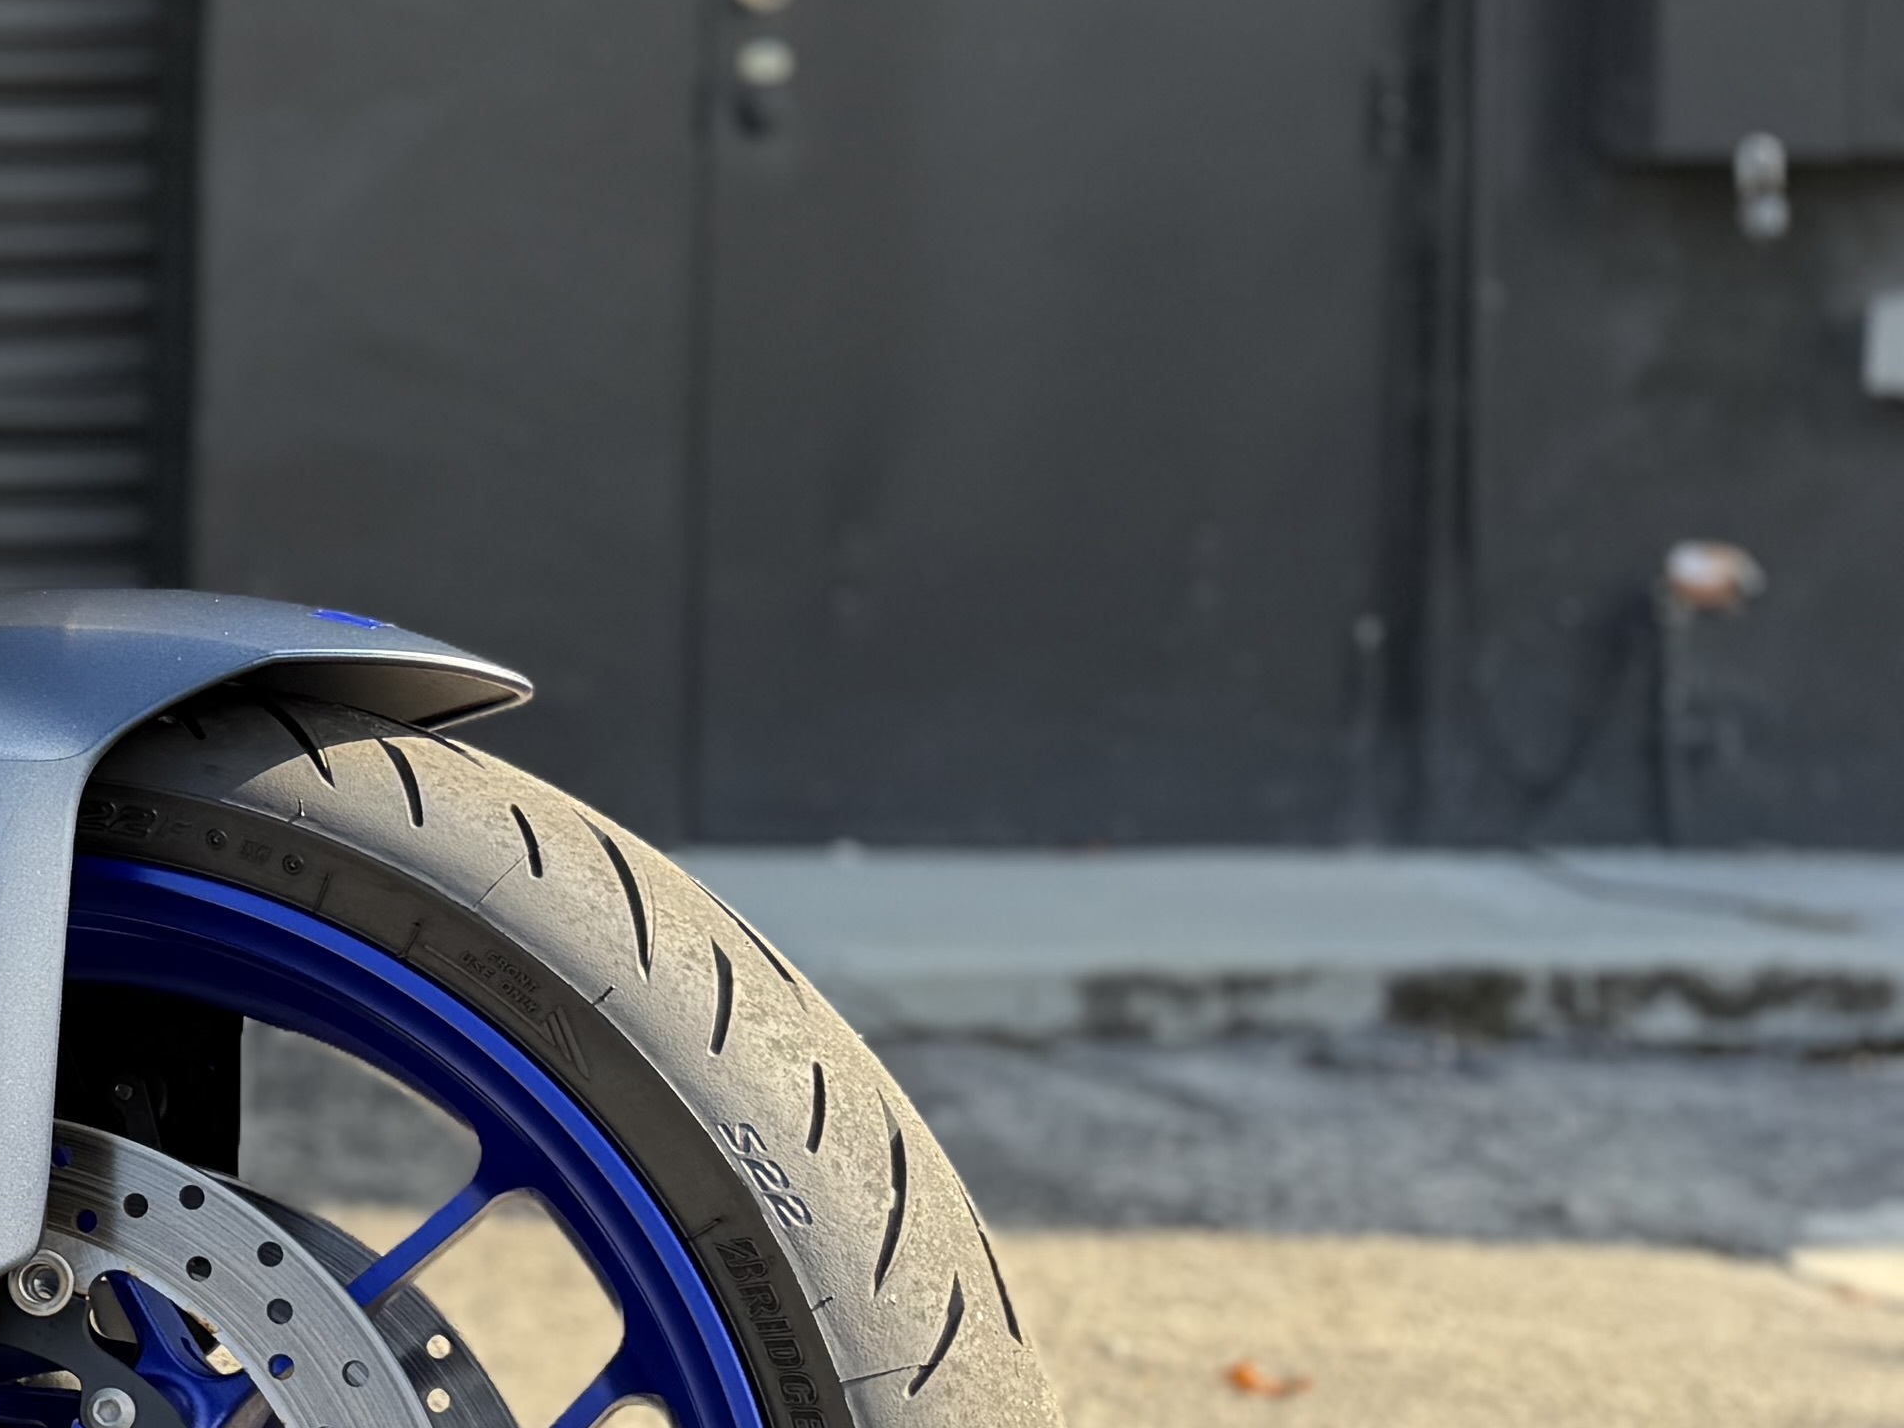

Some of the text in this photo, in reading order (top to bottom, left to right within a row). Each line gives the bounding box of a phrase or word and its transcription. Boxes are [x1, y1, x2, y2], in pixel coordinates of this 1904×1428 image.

[459, 952, 497, 980] USE
[485, 950, 540, 993] FRONT
[716, 1121, 813, 1229] S22
